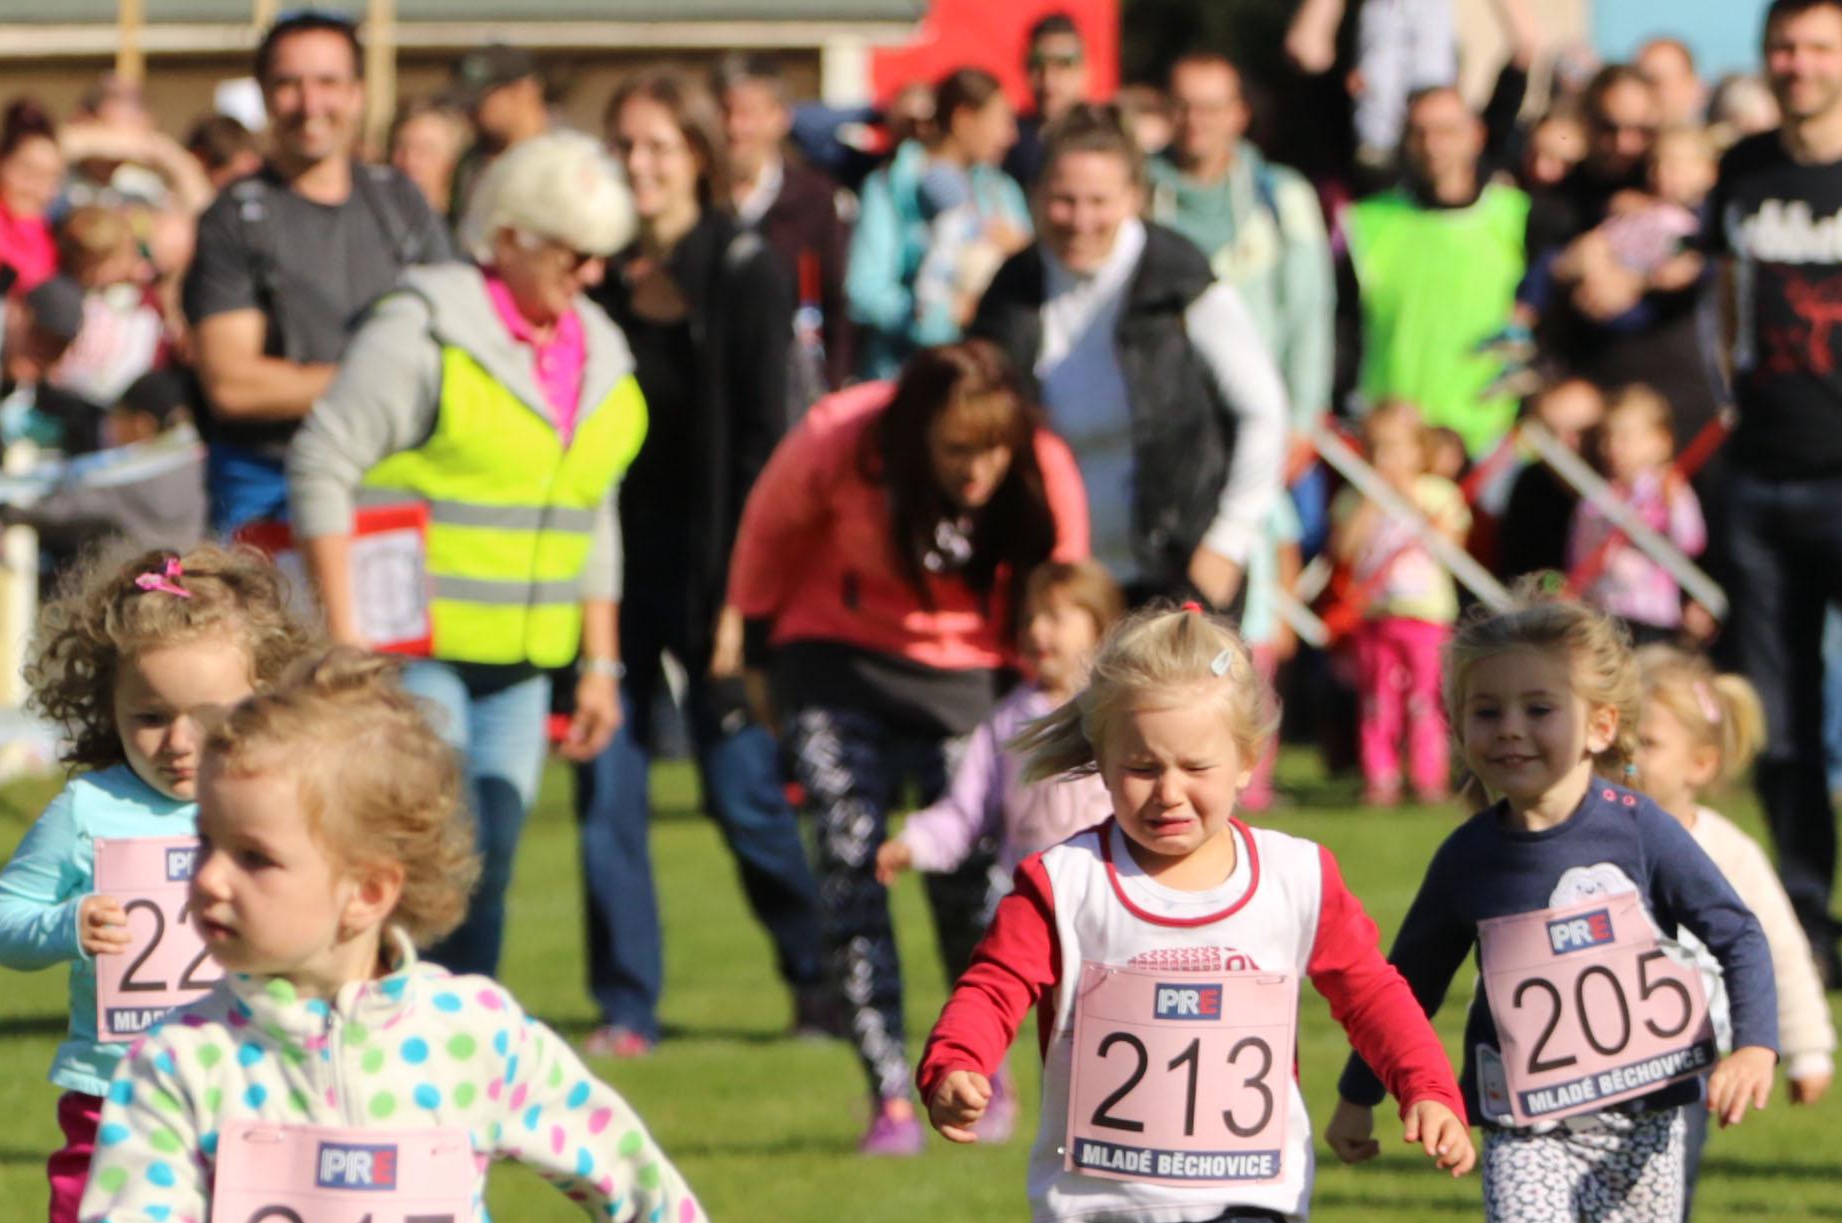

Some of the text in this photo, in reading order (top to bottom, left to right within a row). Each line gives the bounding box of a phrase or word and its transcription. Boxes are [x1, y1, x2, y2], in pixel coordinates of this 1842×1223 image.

[1550, 915, 1612, 949] PRE
[1158, 989, 1219, 1015] PRE
[1512, 951, 1693, 1074] 205
[1090, 1032, 1274, 1138] 213
[1527, 1077, 1597, 1114] MLADÉ
[320, 1149, 394, 1185] PRE
[1082, 1144, 1273, 1177] MLADÉ BĚCHOVICE
